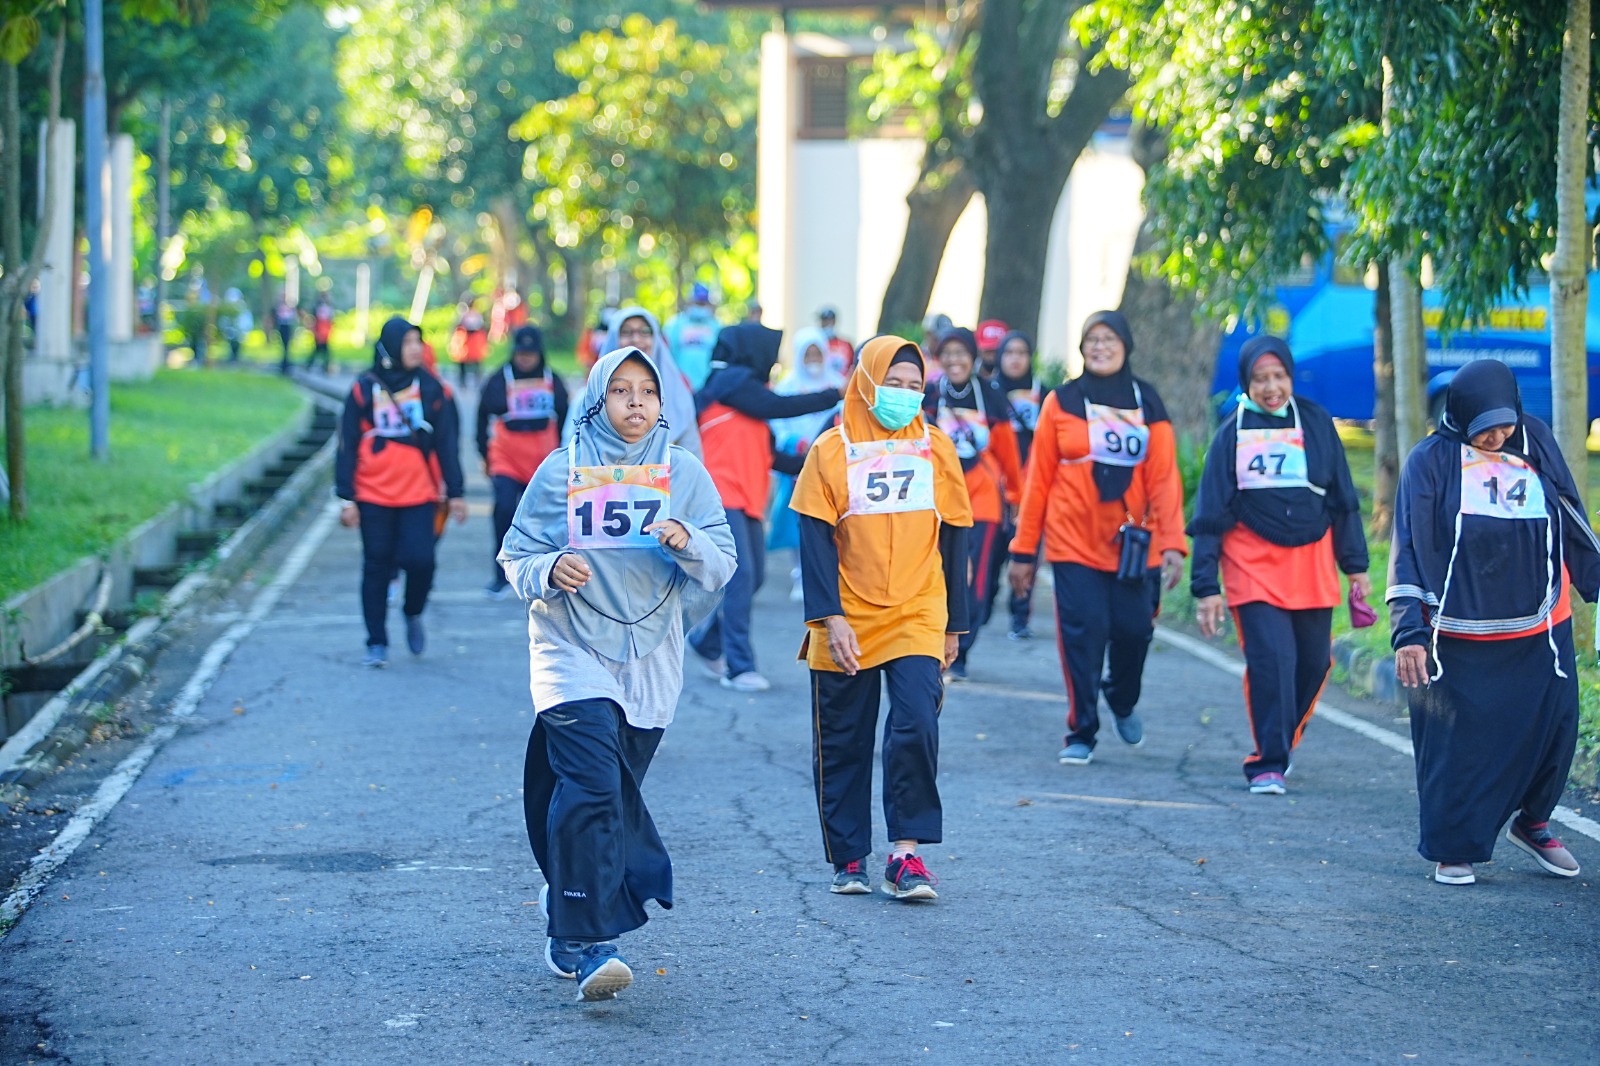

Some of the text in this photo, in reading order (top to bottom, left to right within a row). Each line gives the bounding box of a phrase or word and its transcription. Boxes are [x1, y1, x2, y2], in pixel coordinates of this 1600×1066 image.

[1104, 431, 1141, 457] 90
[1248, 453, 1287, 475] 47
[866, 469, 915, 502] 57
[1483, 476, 1527, 507] 14
[575, 500, 661, 537] 157
